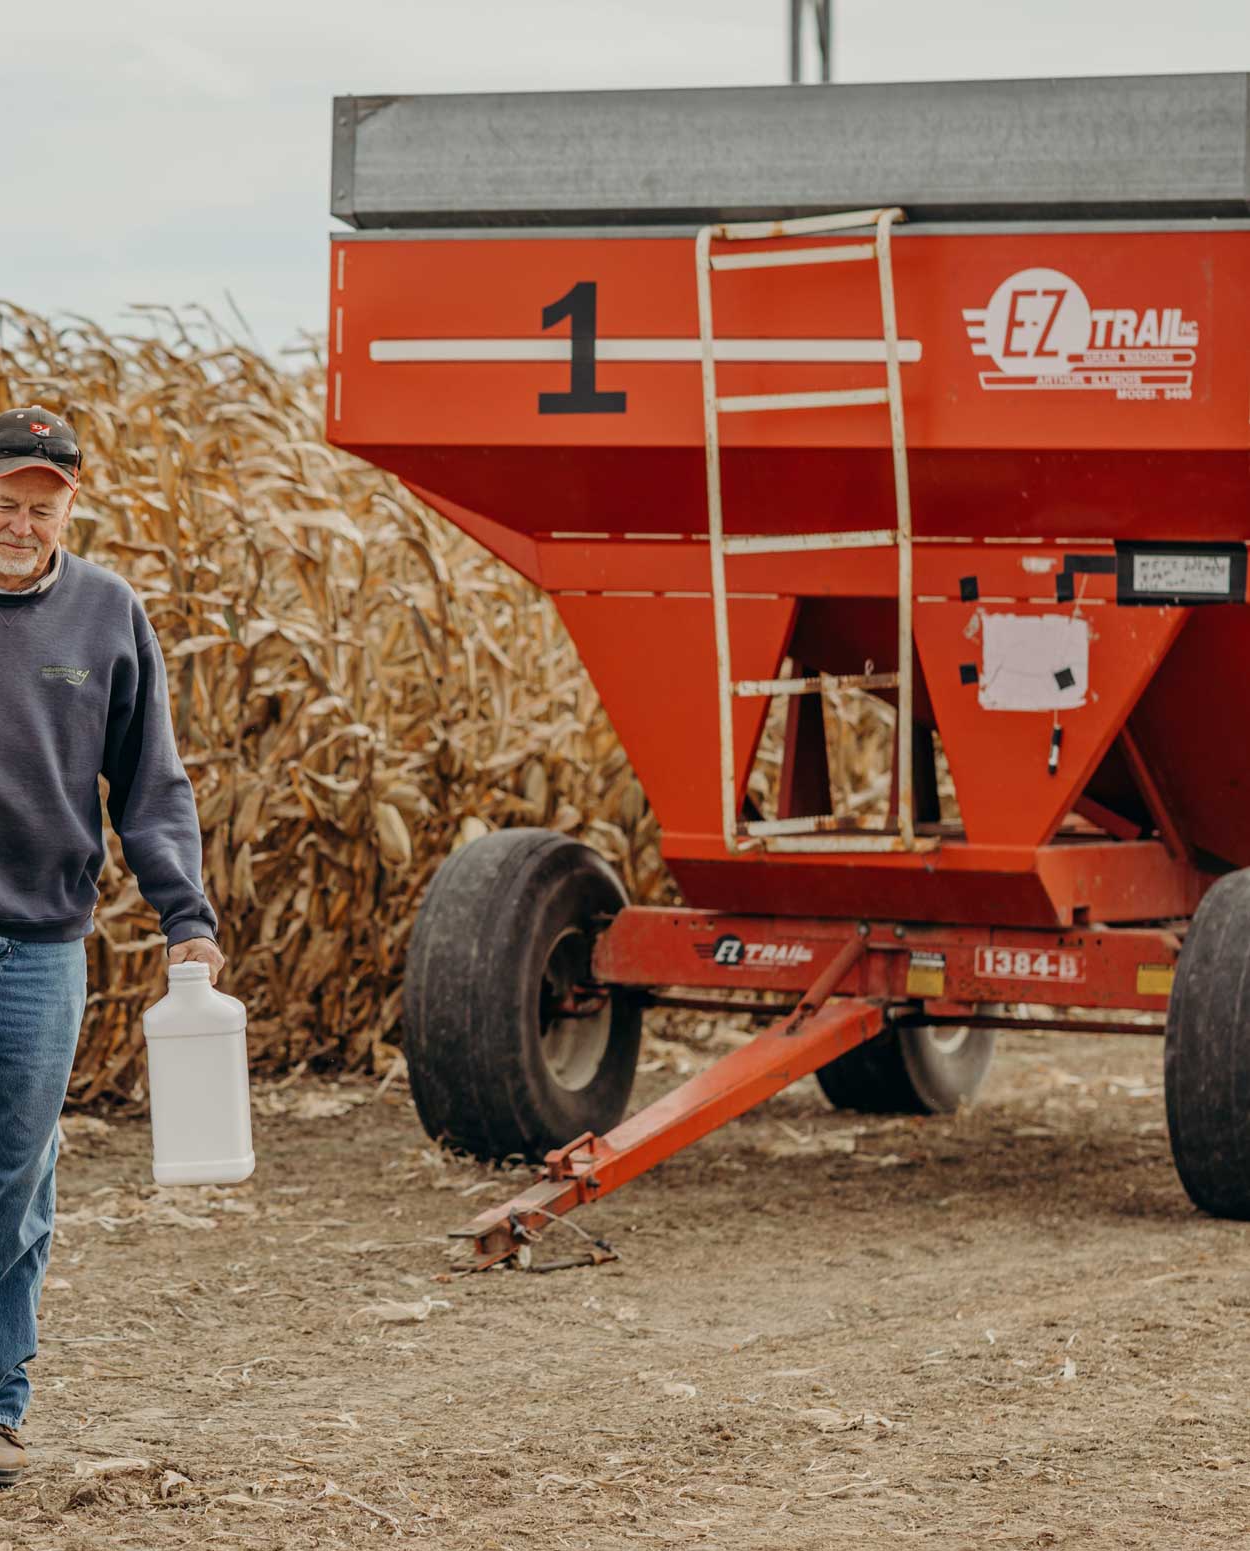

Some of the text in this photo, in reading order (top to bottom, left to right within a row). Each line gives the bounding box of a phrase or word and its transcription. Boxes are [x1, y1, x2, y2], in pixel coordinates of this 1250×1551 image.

[1091, 308, 1198, 347] TRAIL
[538, 281, 627, 415] 1
[744, 943, 811, 964] TRAIL
[982, 949, 1079, 979] 1384-B
